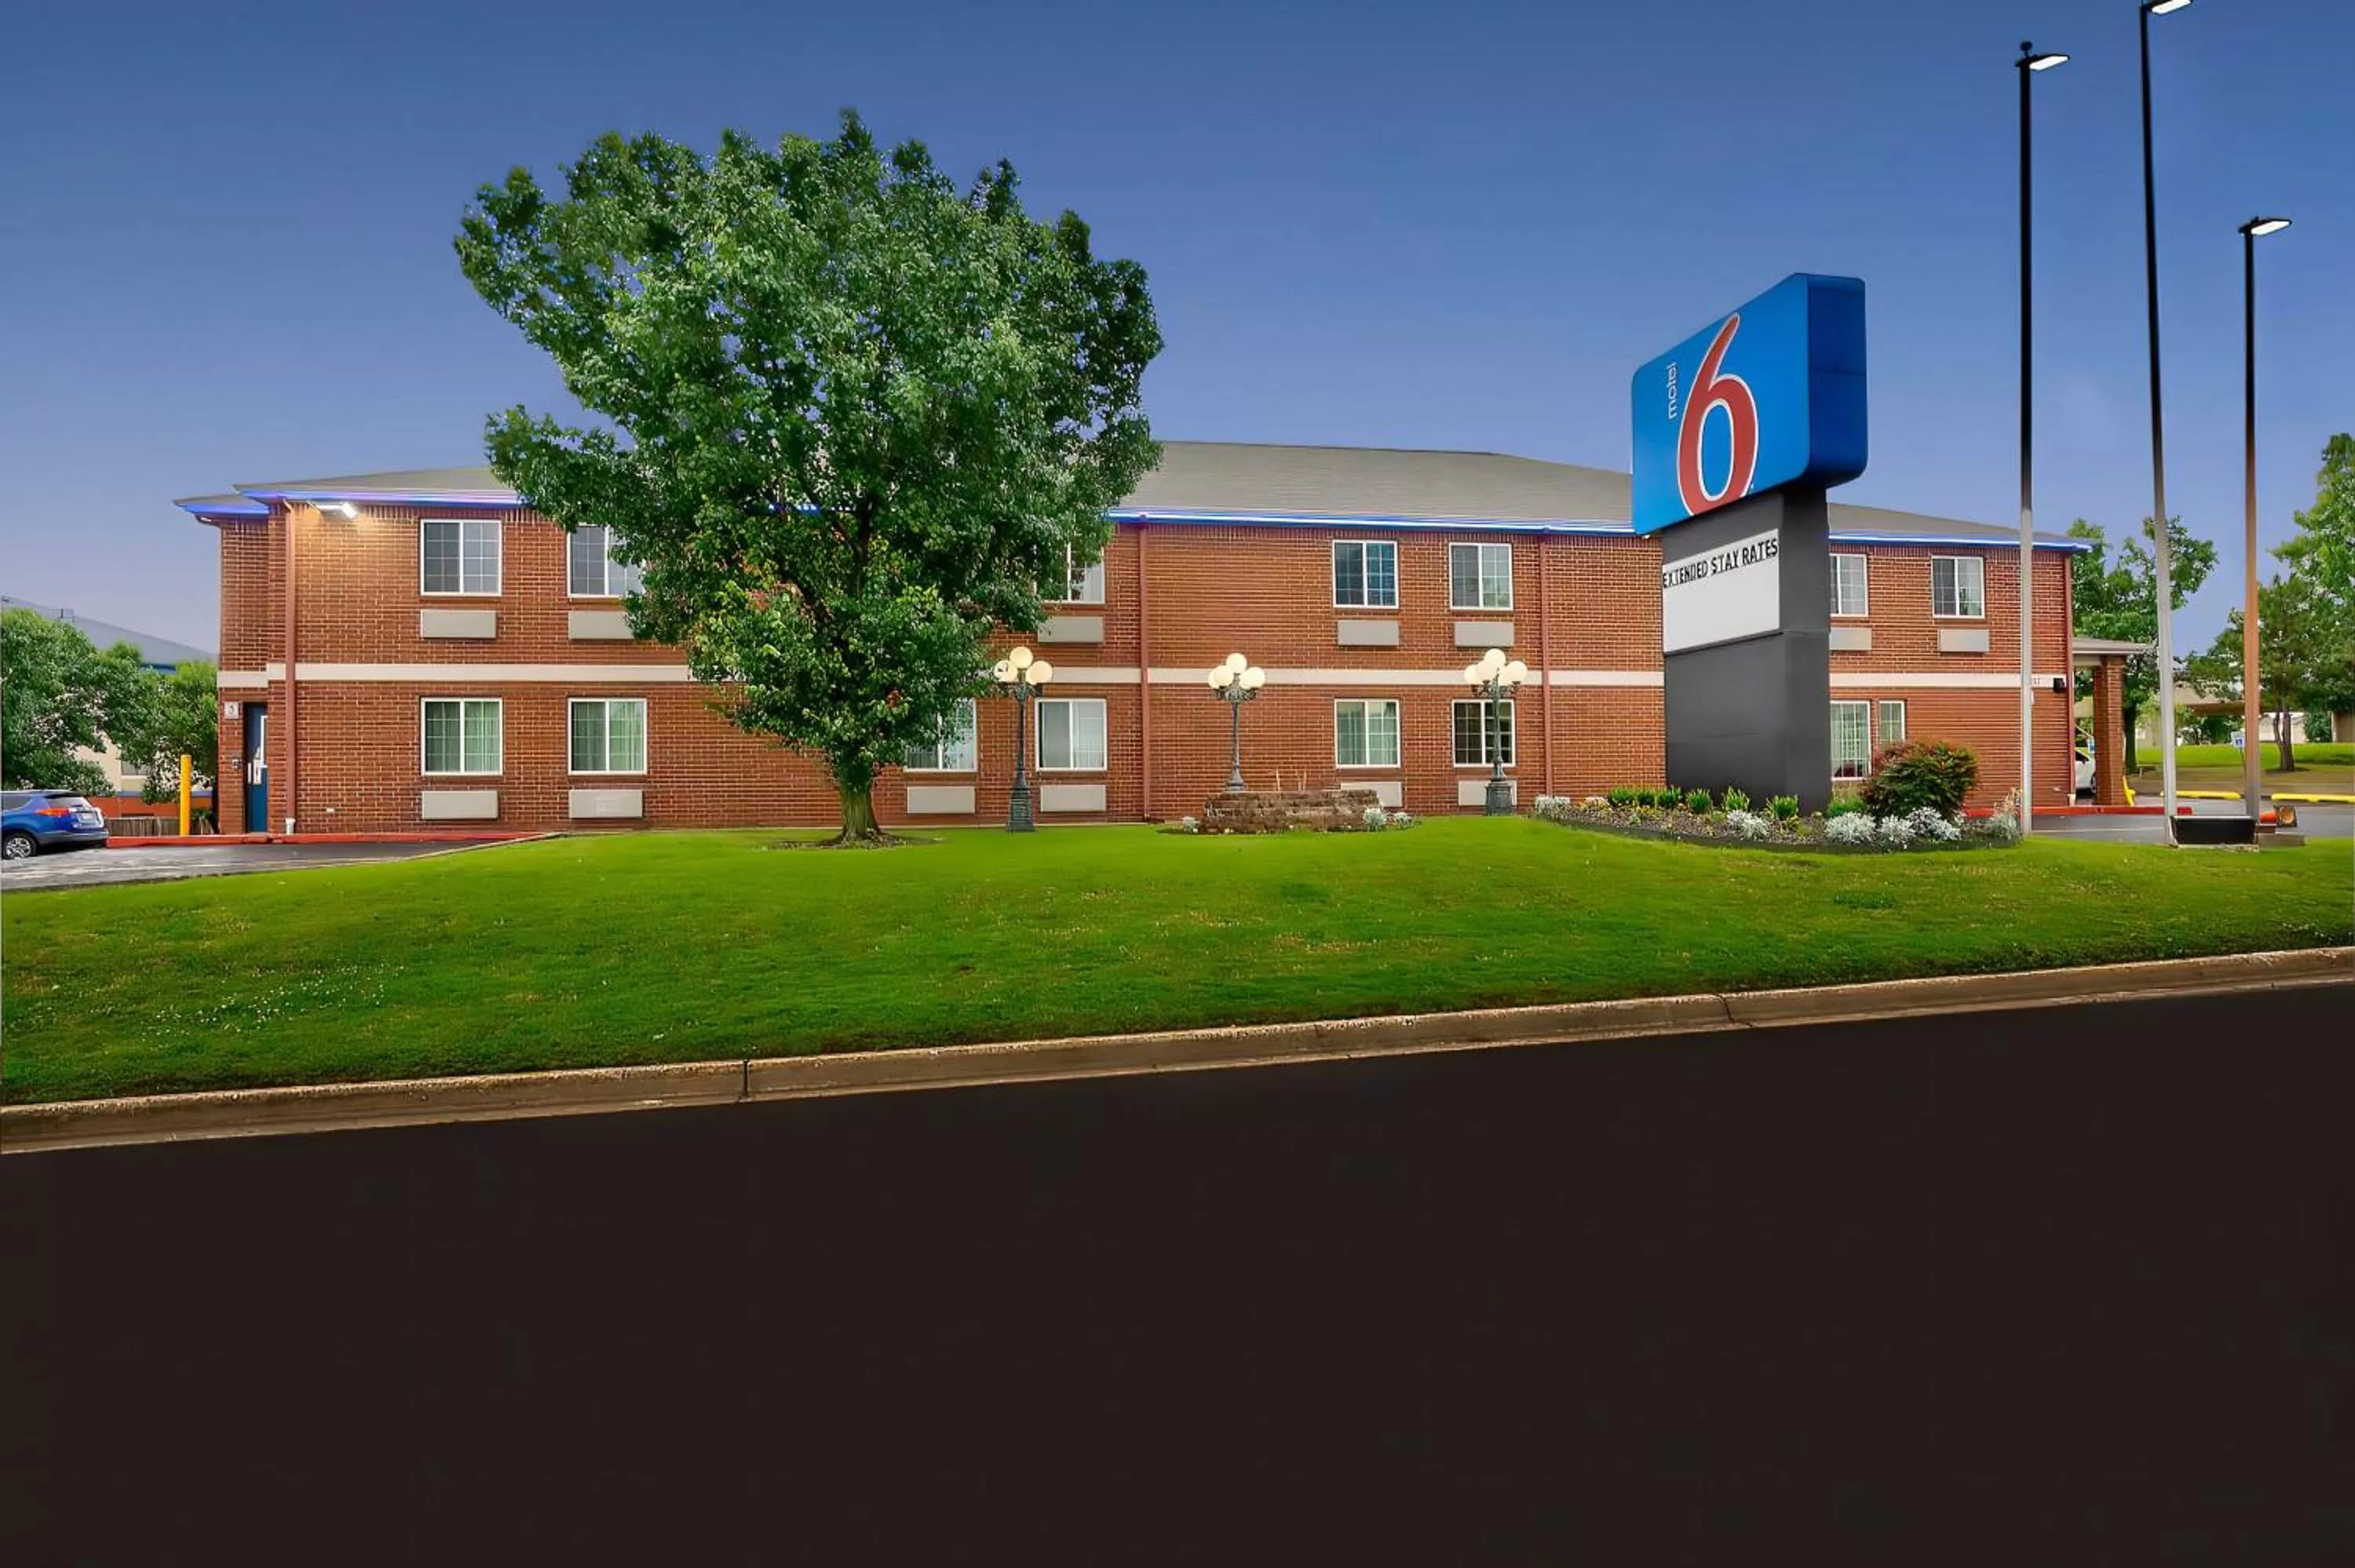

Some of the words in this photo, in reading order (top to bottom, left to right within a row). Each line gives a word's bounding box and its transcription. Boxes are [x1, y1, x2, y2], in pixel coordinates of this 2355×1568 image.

[1667, 362, 1677, 420] motel
[1677, 313, 1758, 516] 6
[1663, 560, 1709, 588] EXTENDED
[1711, 549, 1739, 575] STAY
[1742, 538, 1778, 566] RATES
